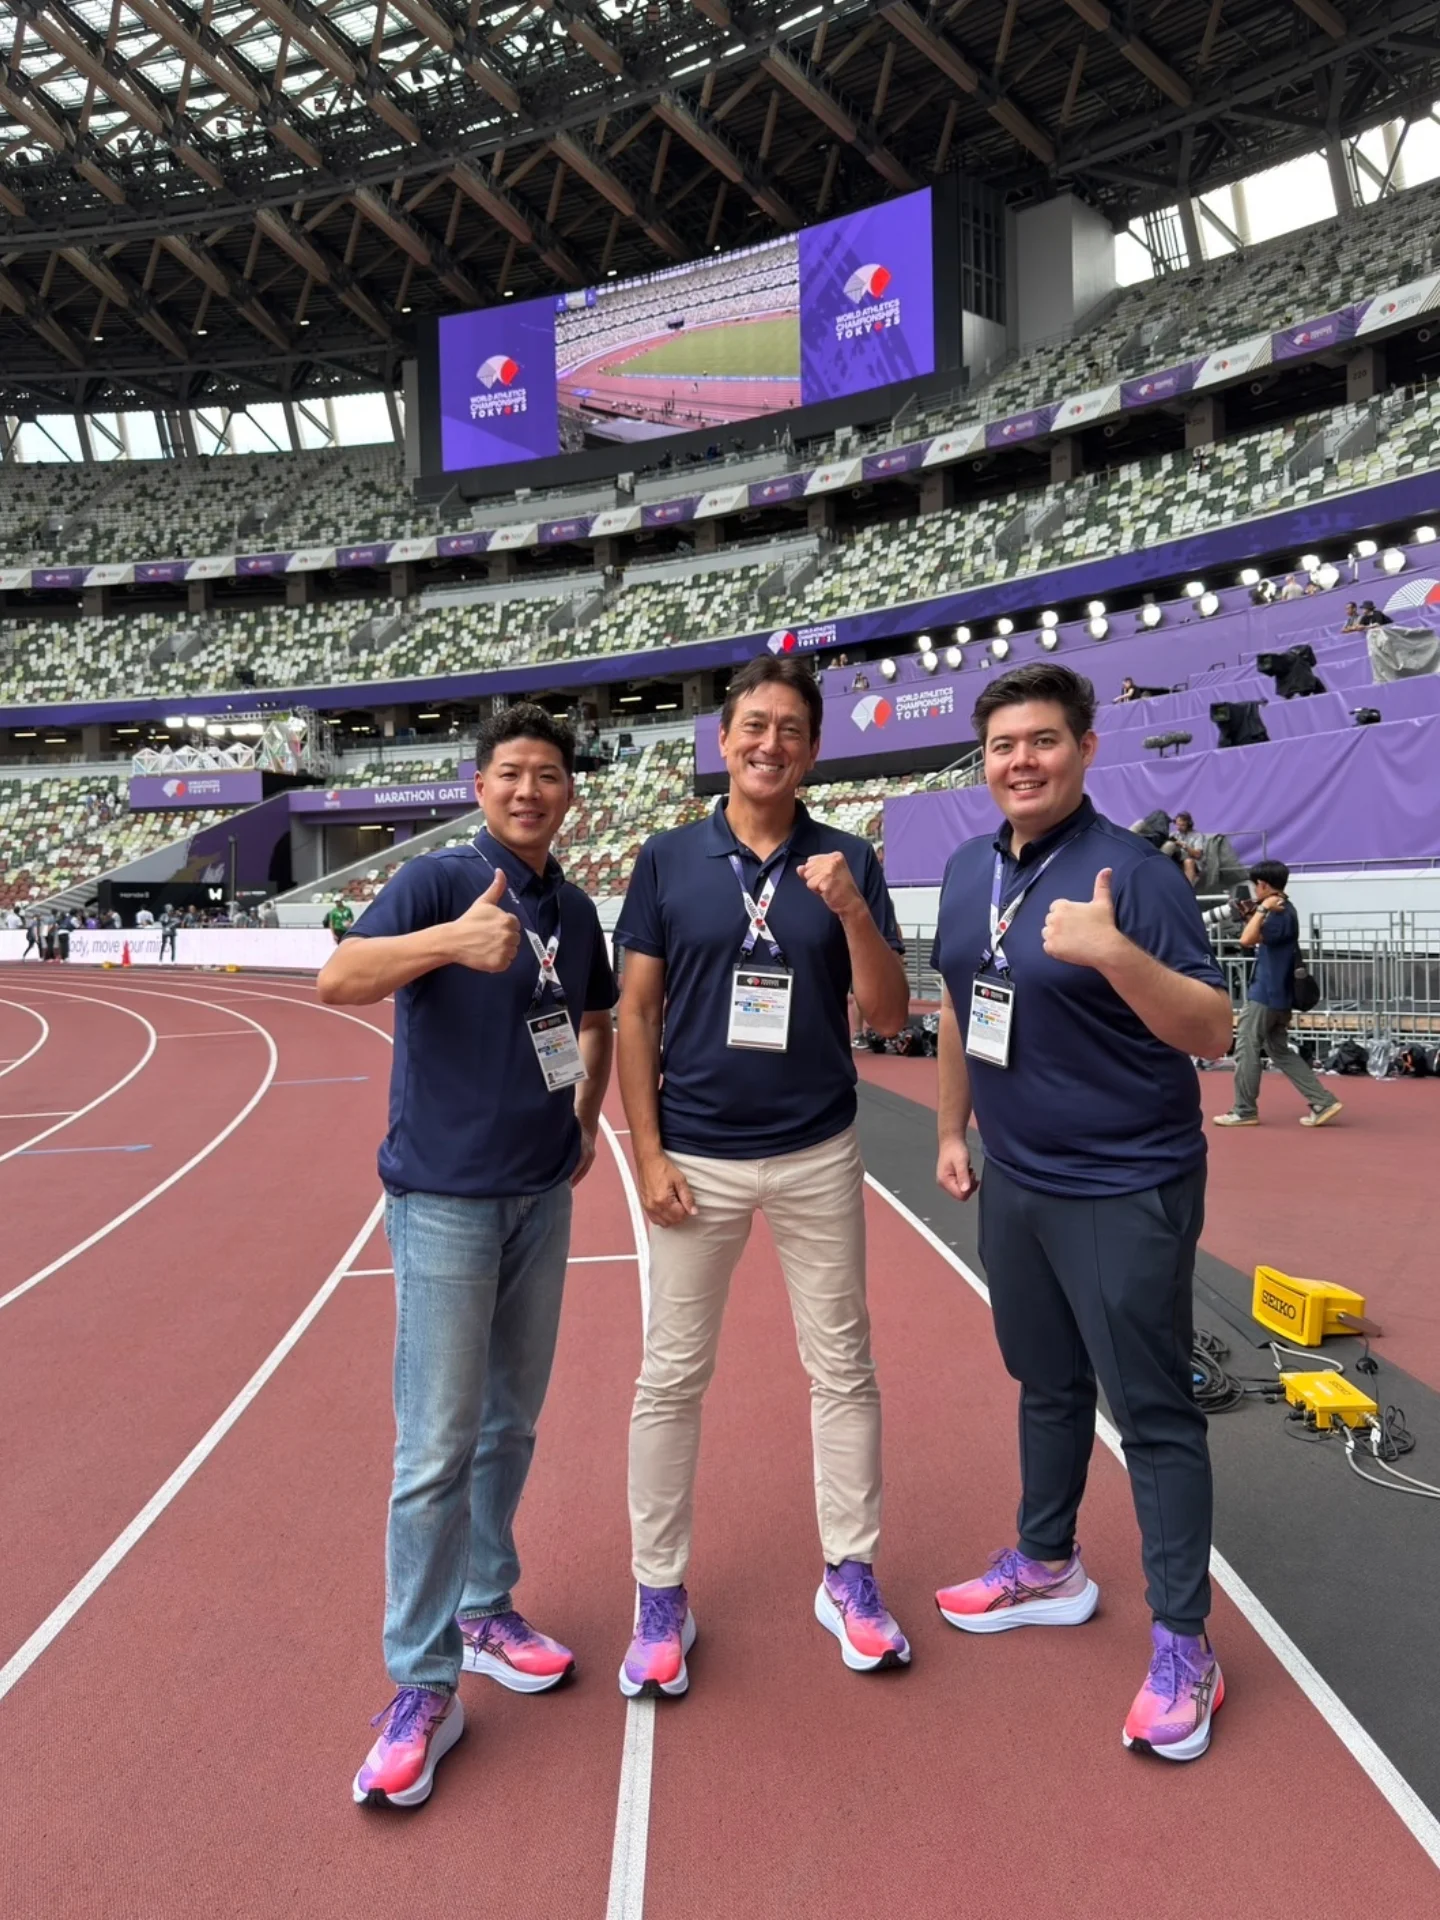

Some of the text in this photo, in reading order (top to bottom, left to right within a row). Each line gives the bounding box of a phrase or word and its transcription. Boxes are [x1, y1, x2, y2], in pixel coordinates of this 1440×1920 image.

[836, 298, 900, 323] WORLD ATHLETICS
[836, 306, 900, 331] CHAMPIONSHIPS
[470, 388, 526, 404] WORLD ATHLETICS
[470, 397, 527, 411] CHAMPIONSHIPS
[896, 687, 953, 703] WORLD ATHLETICS
[896, 695, 953, 712] CHAMPIONSHIPS
[374, 787, 468, 804] MARATHON GATE
[69, 936, 90, 957] ody,
[92, 939, 120, 953] move
[1262, 1289, 1297, 1320] SEIKO
